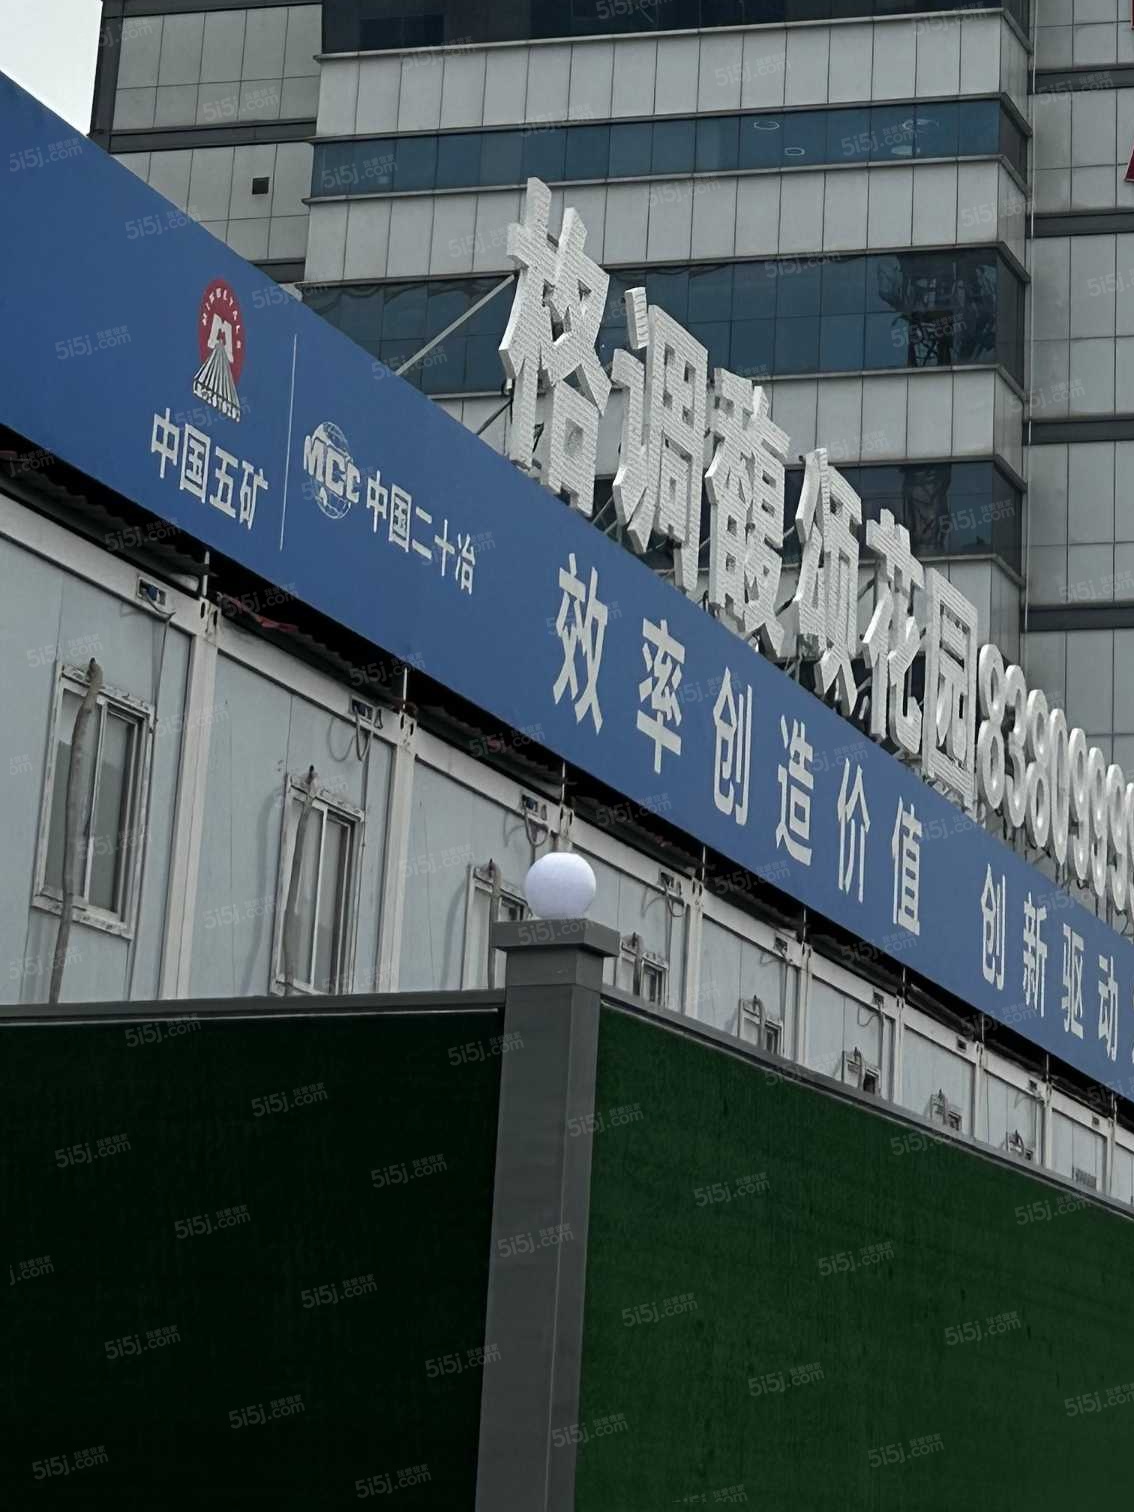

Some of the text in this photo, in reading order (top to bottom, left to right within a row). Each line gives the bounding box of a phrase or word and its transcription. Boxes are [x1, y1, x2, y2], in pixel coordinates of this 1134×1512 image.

[151, 407, 268, 530] 中国五矿
[304, 435, 361, 504] MCC
[553, 553, 920, 936] 效率创造价值
